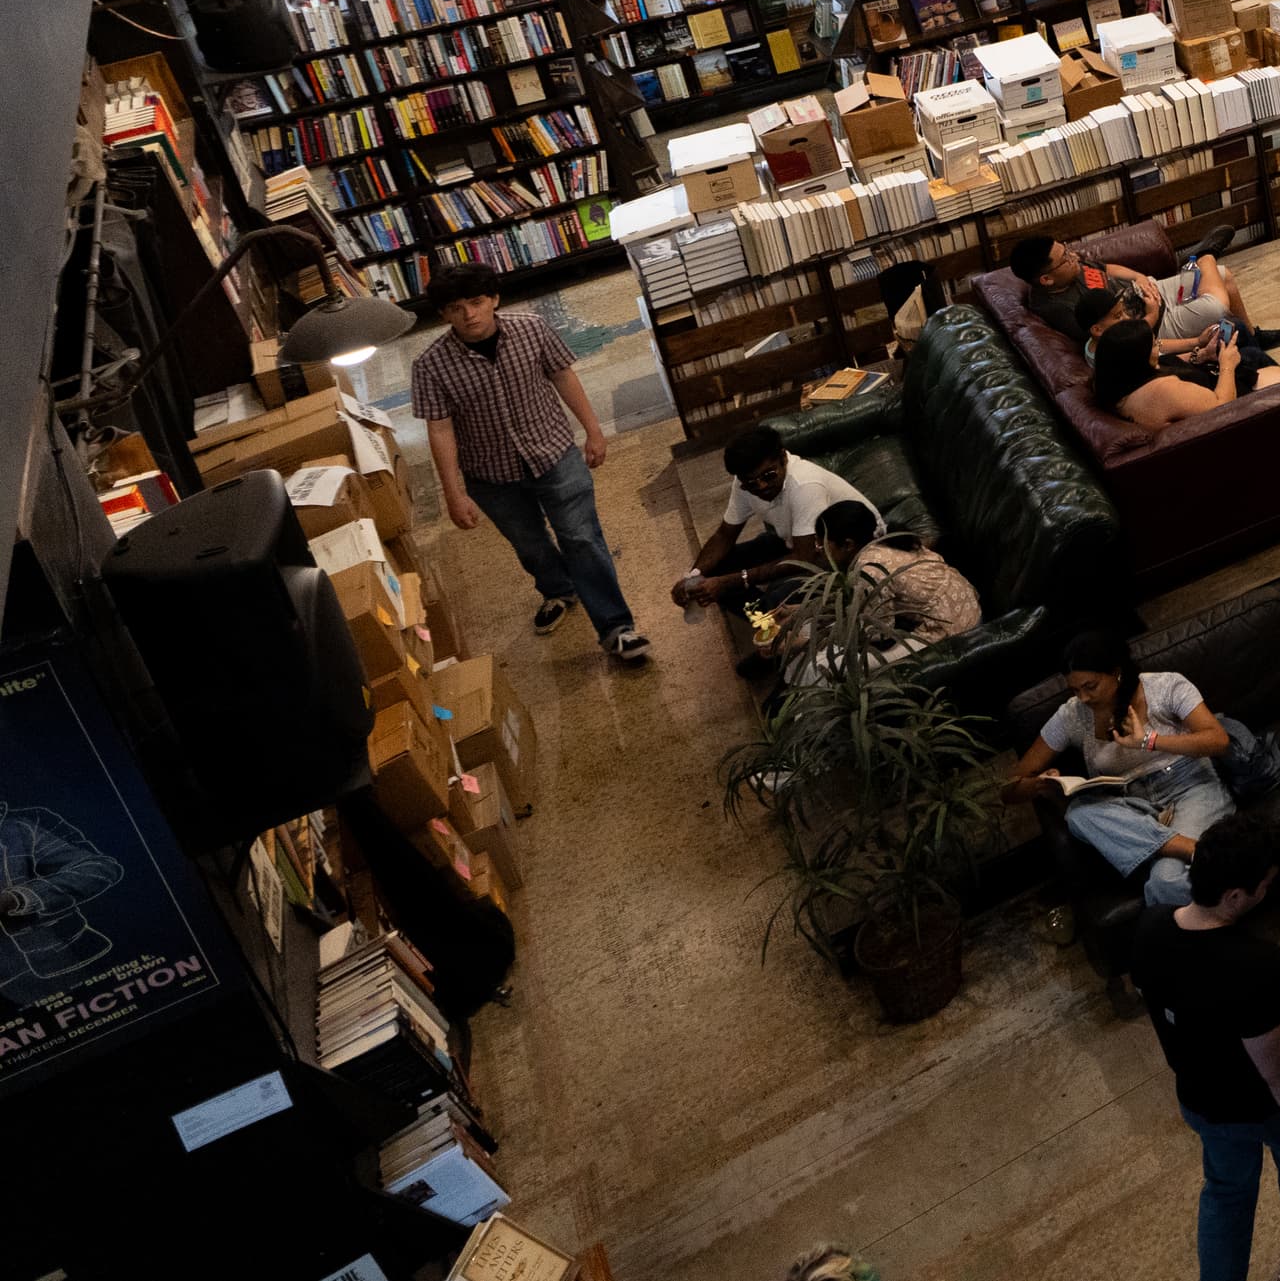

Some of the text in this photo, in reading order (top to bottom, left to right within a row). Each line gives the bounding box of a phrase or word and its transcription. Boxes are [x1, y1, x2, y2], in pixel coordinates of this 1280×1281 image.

[84, 960, 139, 988] sterling
[116, 954, 166, 981] brown
[34, 991, 65, 1009] issa
[45, 994, 74, 1014] rae
[55, 955, 202, 1030] FICTION
[7, 1003, 139, 1066] THEATERS DECEMBER
[475, 1236, 500, 1269] LIVES
[489, 1244, 508, 1271] AND
